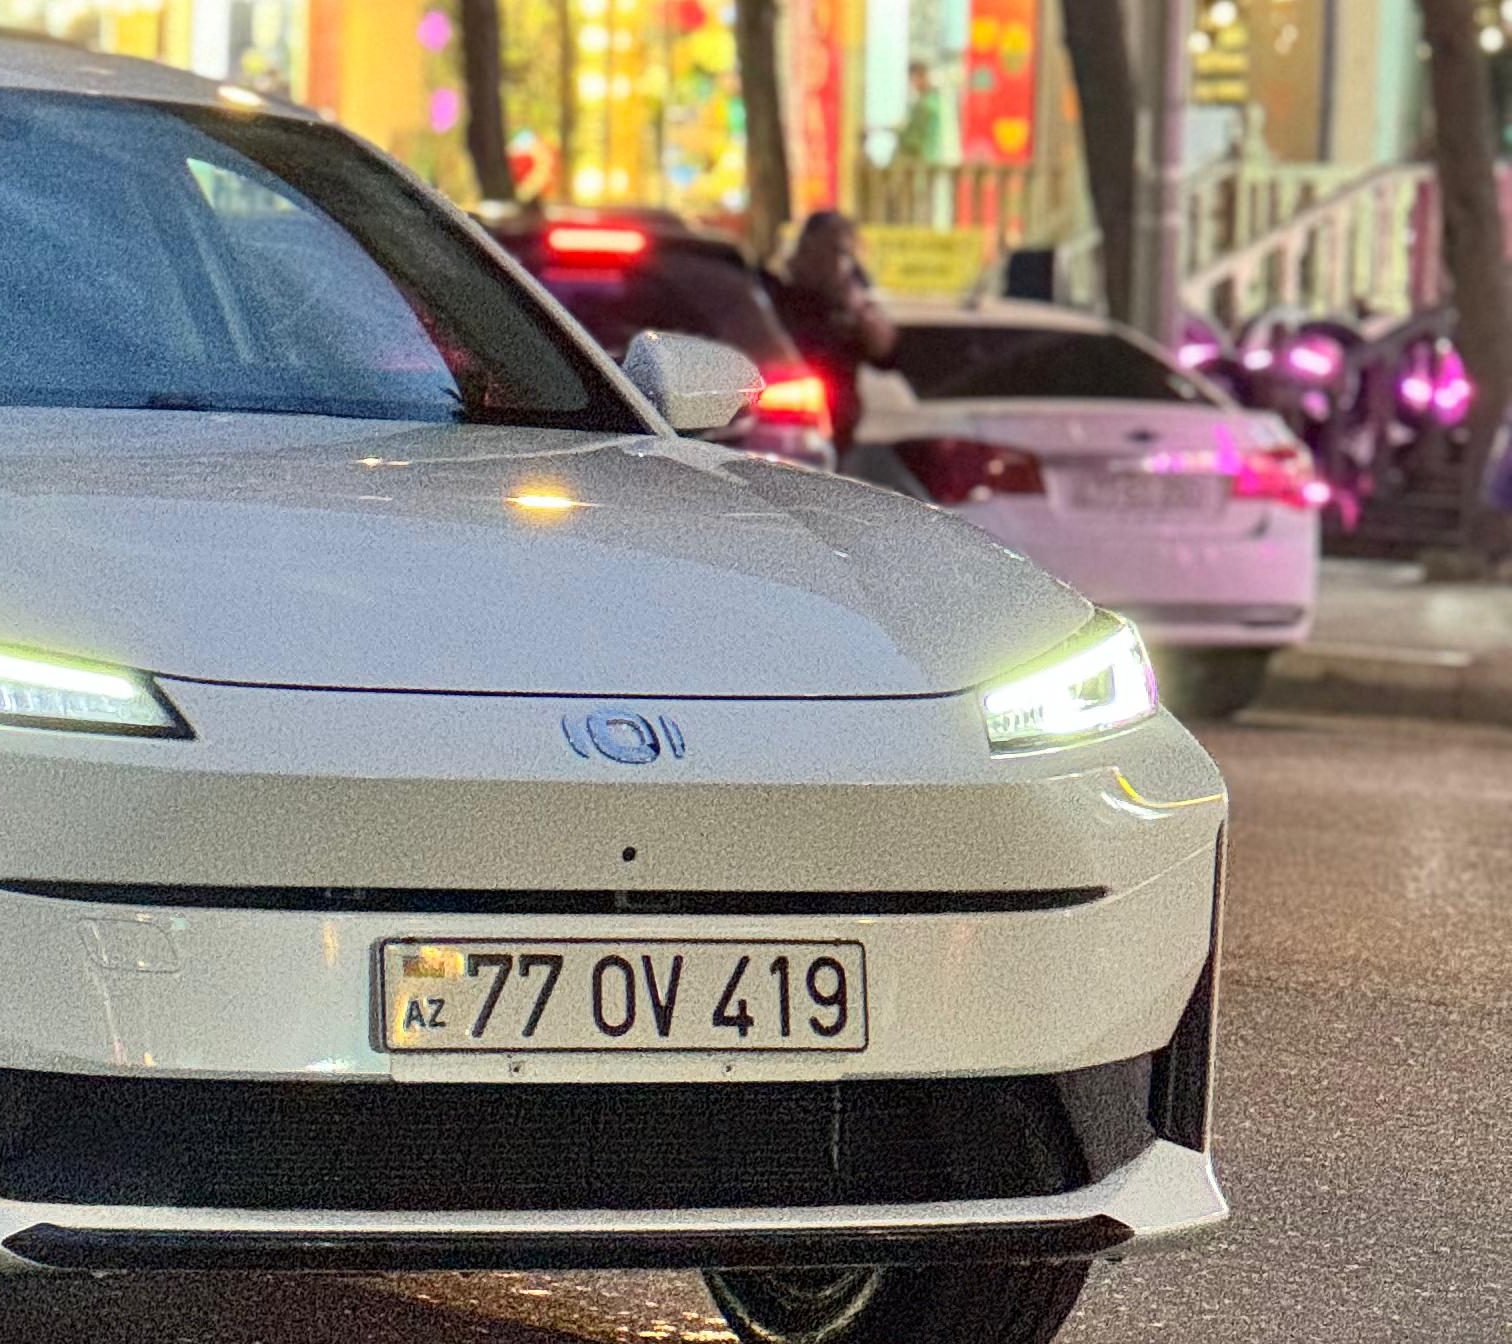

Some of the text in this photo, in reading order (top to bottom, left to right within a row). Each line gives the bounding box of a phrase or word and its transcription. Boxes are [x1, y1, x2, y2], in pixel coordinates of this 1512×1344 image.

[402, 998, 446, 1029] AZ
[466, 953, 848, 1038] 77 OV 419
